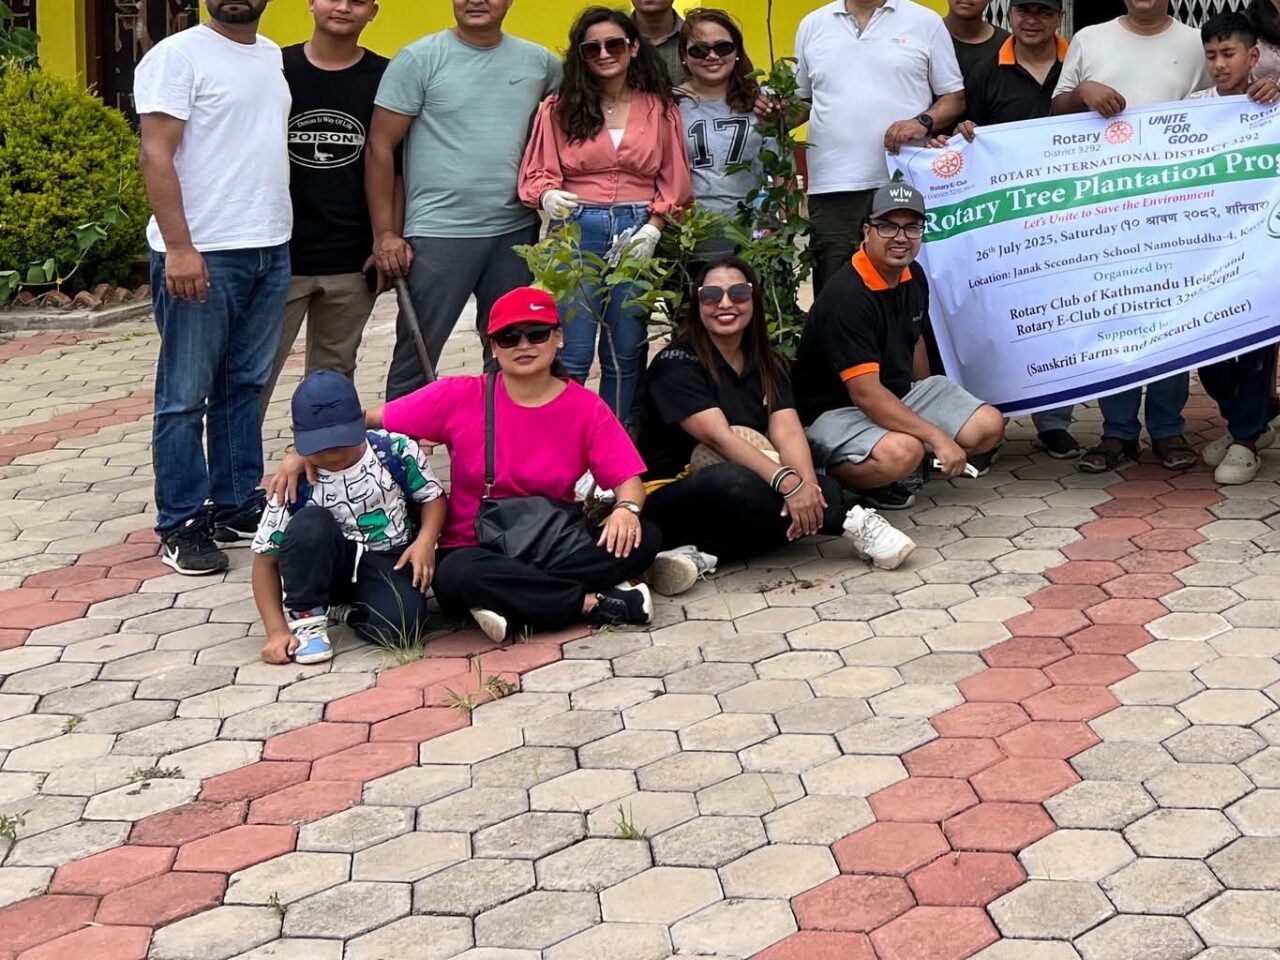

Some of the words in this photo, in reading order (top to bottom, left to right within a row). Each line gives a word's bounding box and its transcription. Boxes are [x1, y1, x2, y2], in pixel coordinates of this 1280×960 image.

[1148, 113, 1188, 126] UNITE
[1163, 123, 1192, 135] FOR
[288, 132, 354, 143] POISON
[688, 116, 750, 169] 17
[1044, 148, 1075, 158] District
[1078, 145, 1101, 154] 3292
[1053, 131, 1101, 146] Rotary
[1168, 133, 1209, 145] GOOD
[990, 166, 1043, 185] ROTARY
[1047, 152, 1160, 175] INTERNATIONAL
[1165, 141, 1226, 160] DISTRICT
[923, 197, 1000, 235] Rotary
[1006, 186, 1066, 212] Tree
[1074, 161, 1217, 201] Plantation
[1050, 212, 1079, 224] Unite
[1081, 210, 1092, 218] to
[1095, 206, 1119, 216] Save
[1122, 200, 1139, 210] the
[1142, 189, 1215, 206] Environment
[976, 246, 996, 262] 26th
[998, 241, 1022, 257] July
[1024, 233, 1058, 250] 2025,
[1060, 223, 1118, 243] Saturday
[1184, 206, 1221, 219] २०८२,
[968, 270, 1011, 289] Location:
[1013, 262, 1042, 278] Janak
[1044, 250, 1100, 271] Secondary
[1103, 243, 1141, 258] School
[1093, 261, 1153, 282] Organized
[1156, 261, 1173, 271] by:
[1010, 302, 1048, 320] Rotary
[1050, 294, 1080, 311] Club
[1083, 291, 1097, 303] of
[1101, 278, 1180, 300] Kathmandu
[1016, 319, 1054, 336] Rotary
[1057, 306, 1101, 325] E-Club
[1104, 302, 1118, 316] of
[1121, 295, 1172, 314] District
[1027, 352, 1077, 377] (Sanskriti
[1081, 345, 1120, 363] Farms
[1123, 340, 1147, 353] and
[1149, 317, 1201, 345] Research
[1204, 298, 1253, 324] Center)
[1097, 321, 1156, 343] Supported
